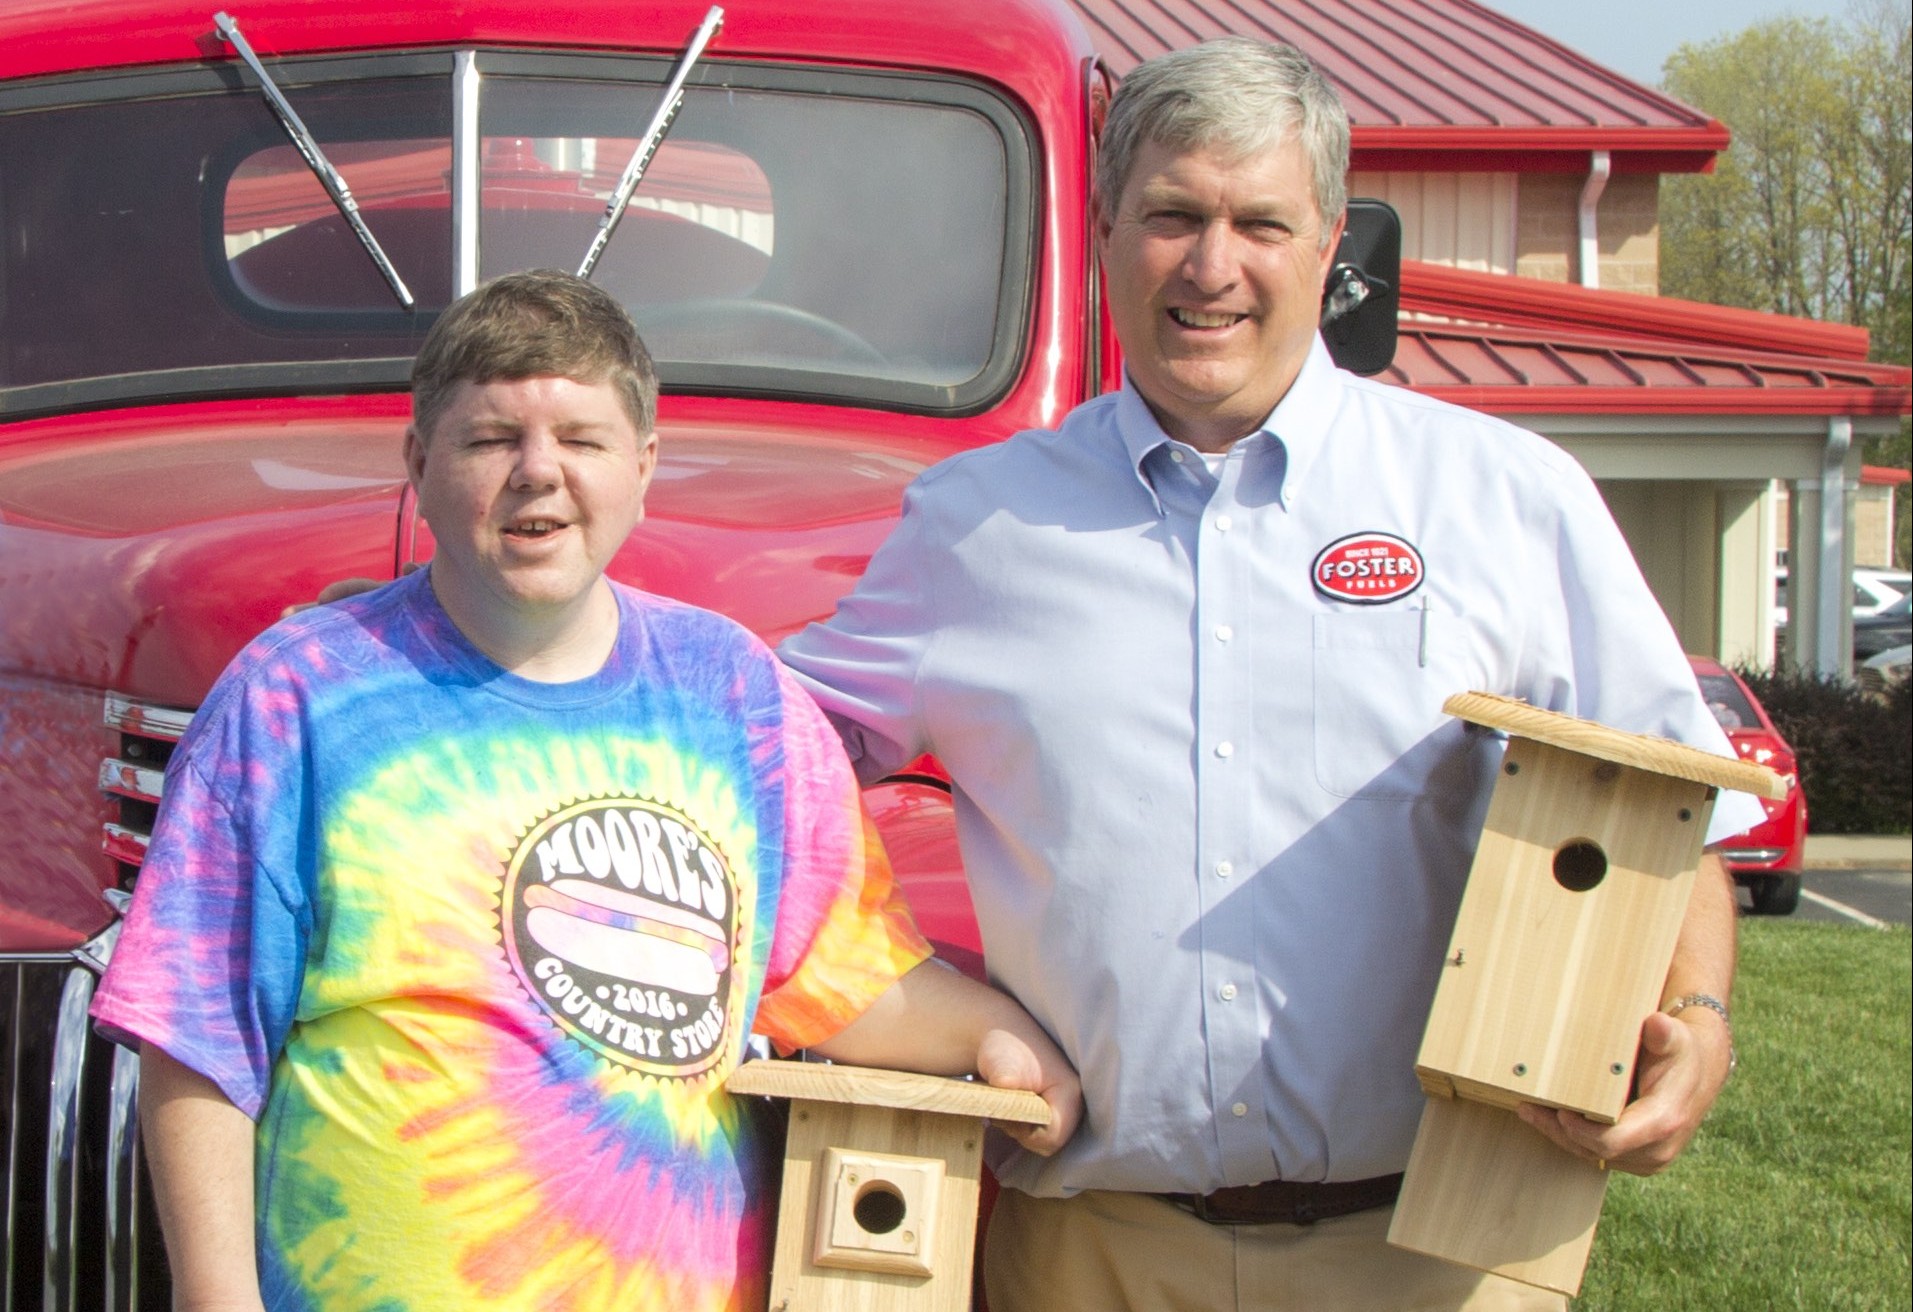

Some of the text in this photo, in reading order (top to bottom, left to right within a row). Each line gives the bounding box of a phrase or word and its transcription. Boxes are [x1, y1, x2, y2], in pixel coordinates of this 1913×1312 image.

[1322, 557, 1415, 580] FOSTER
[1346, 579, 1397, 589] FUELS
[535, 808, 727, 920] MOORE'S
[534, 957, 724, 1059] COUNTRY STORE
